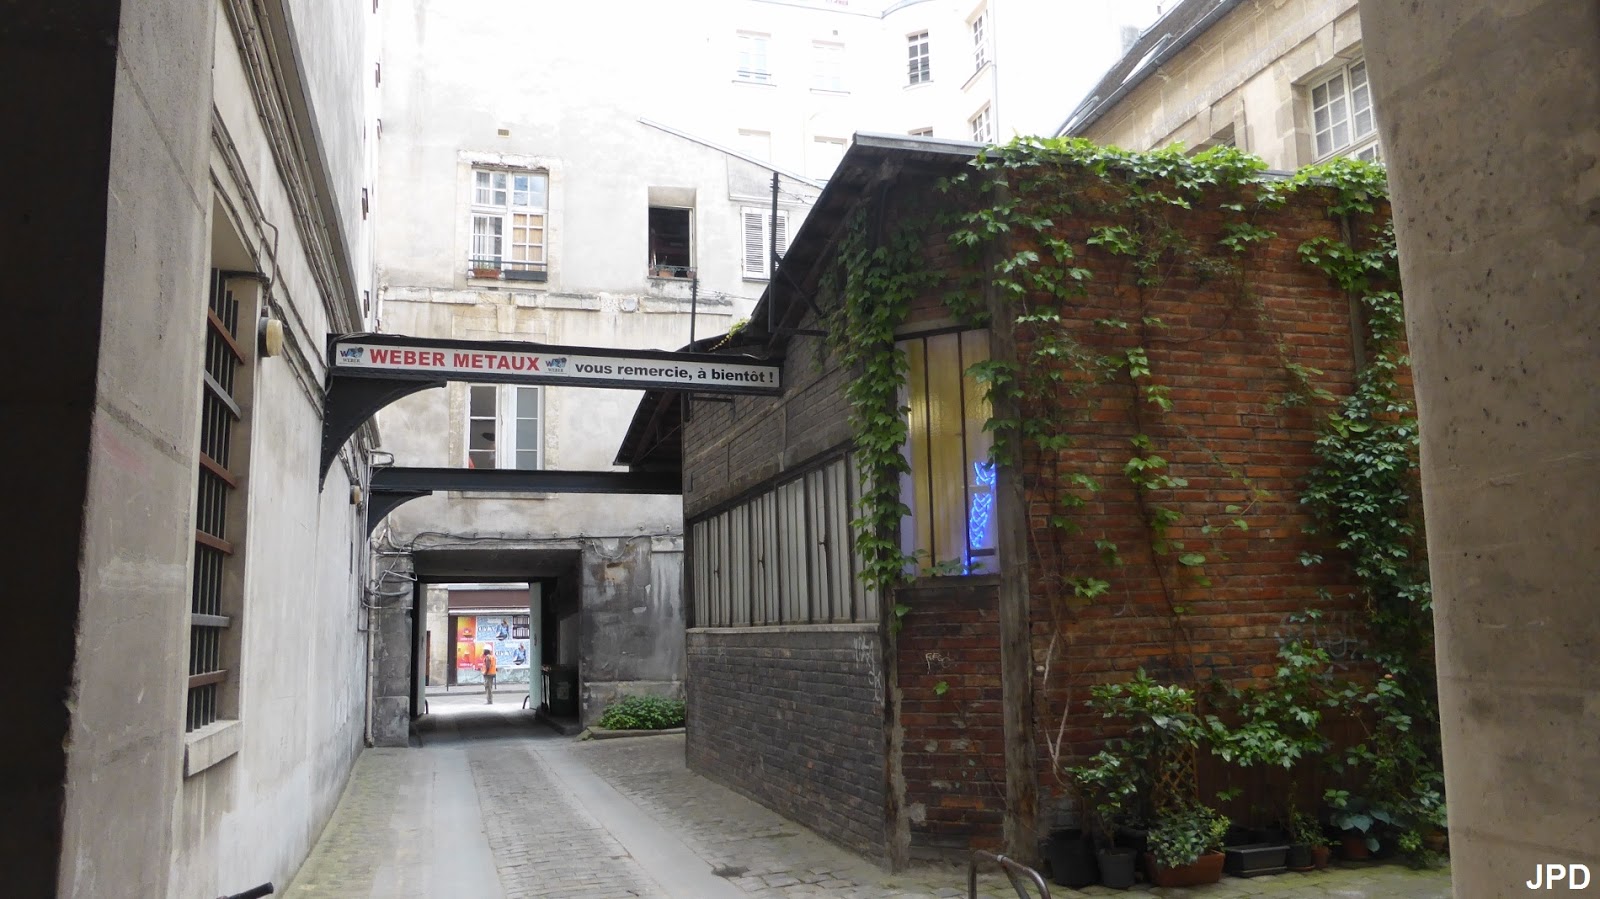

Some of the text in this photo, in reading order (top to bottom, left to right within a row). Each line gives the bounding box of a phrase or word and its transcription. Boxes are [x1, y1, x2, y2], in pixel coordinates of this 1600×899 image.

[370, 348, 540, 371] WEBER METAUX
[574, 362, 774, 383] vous remercie, à bientôt !
